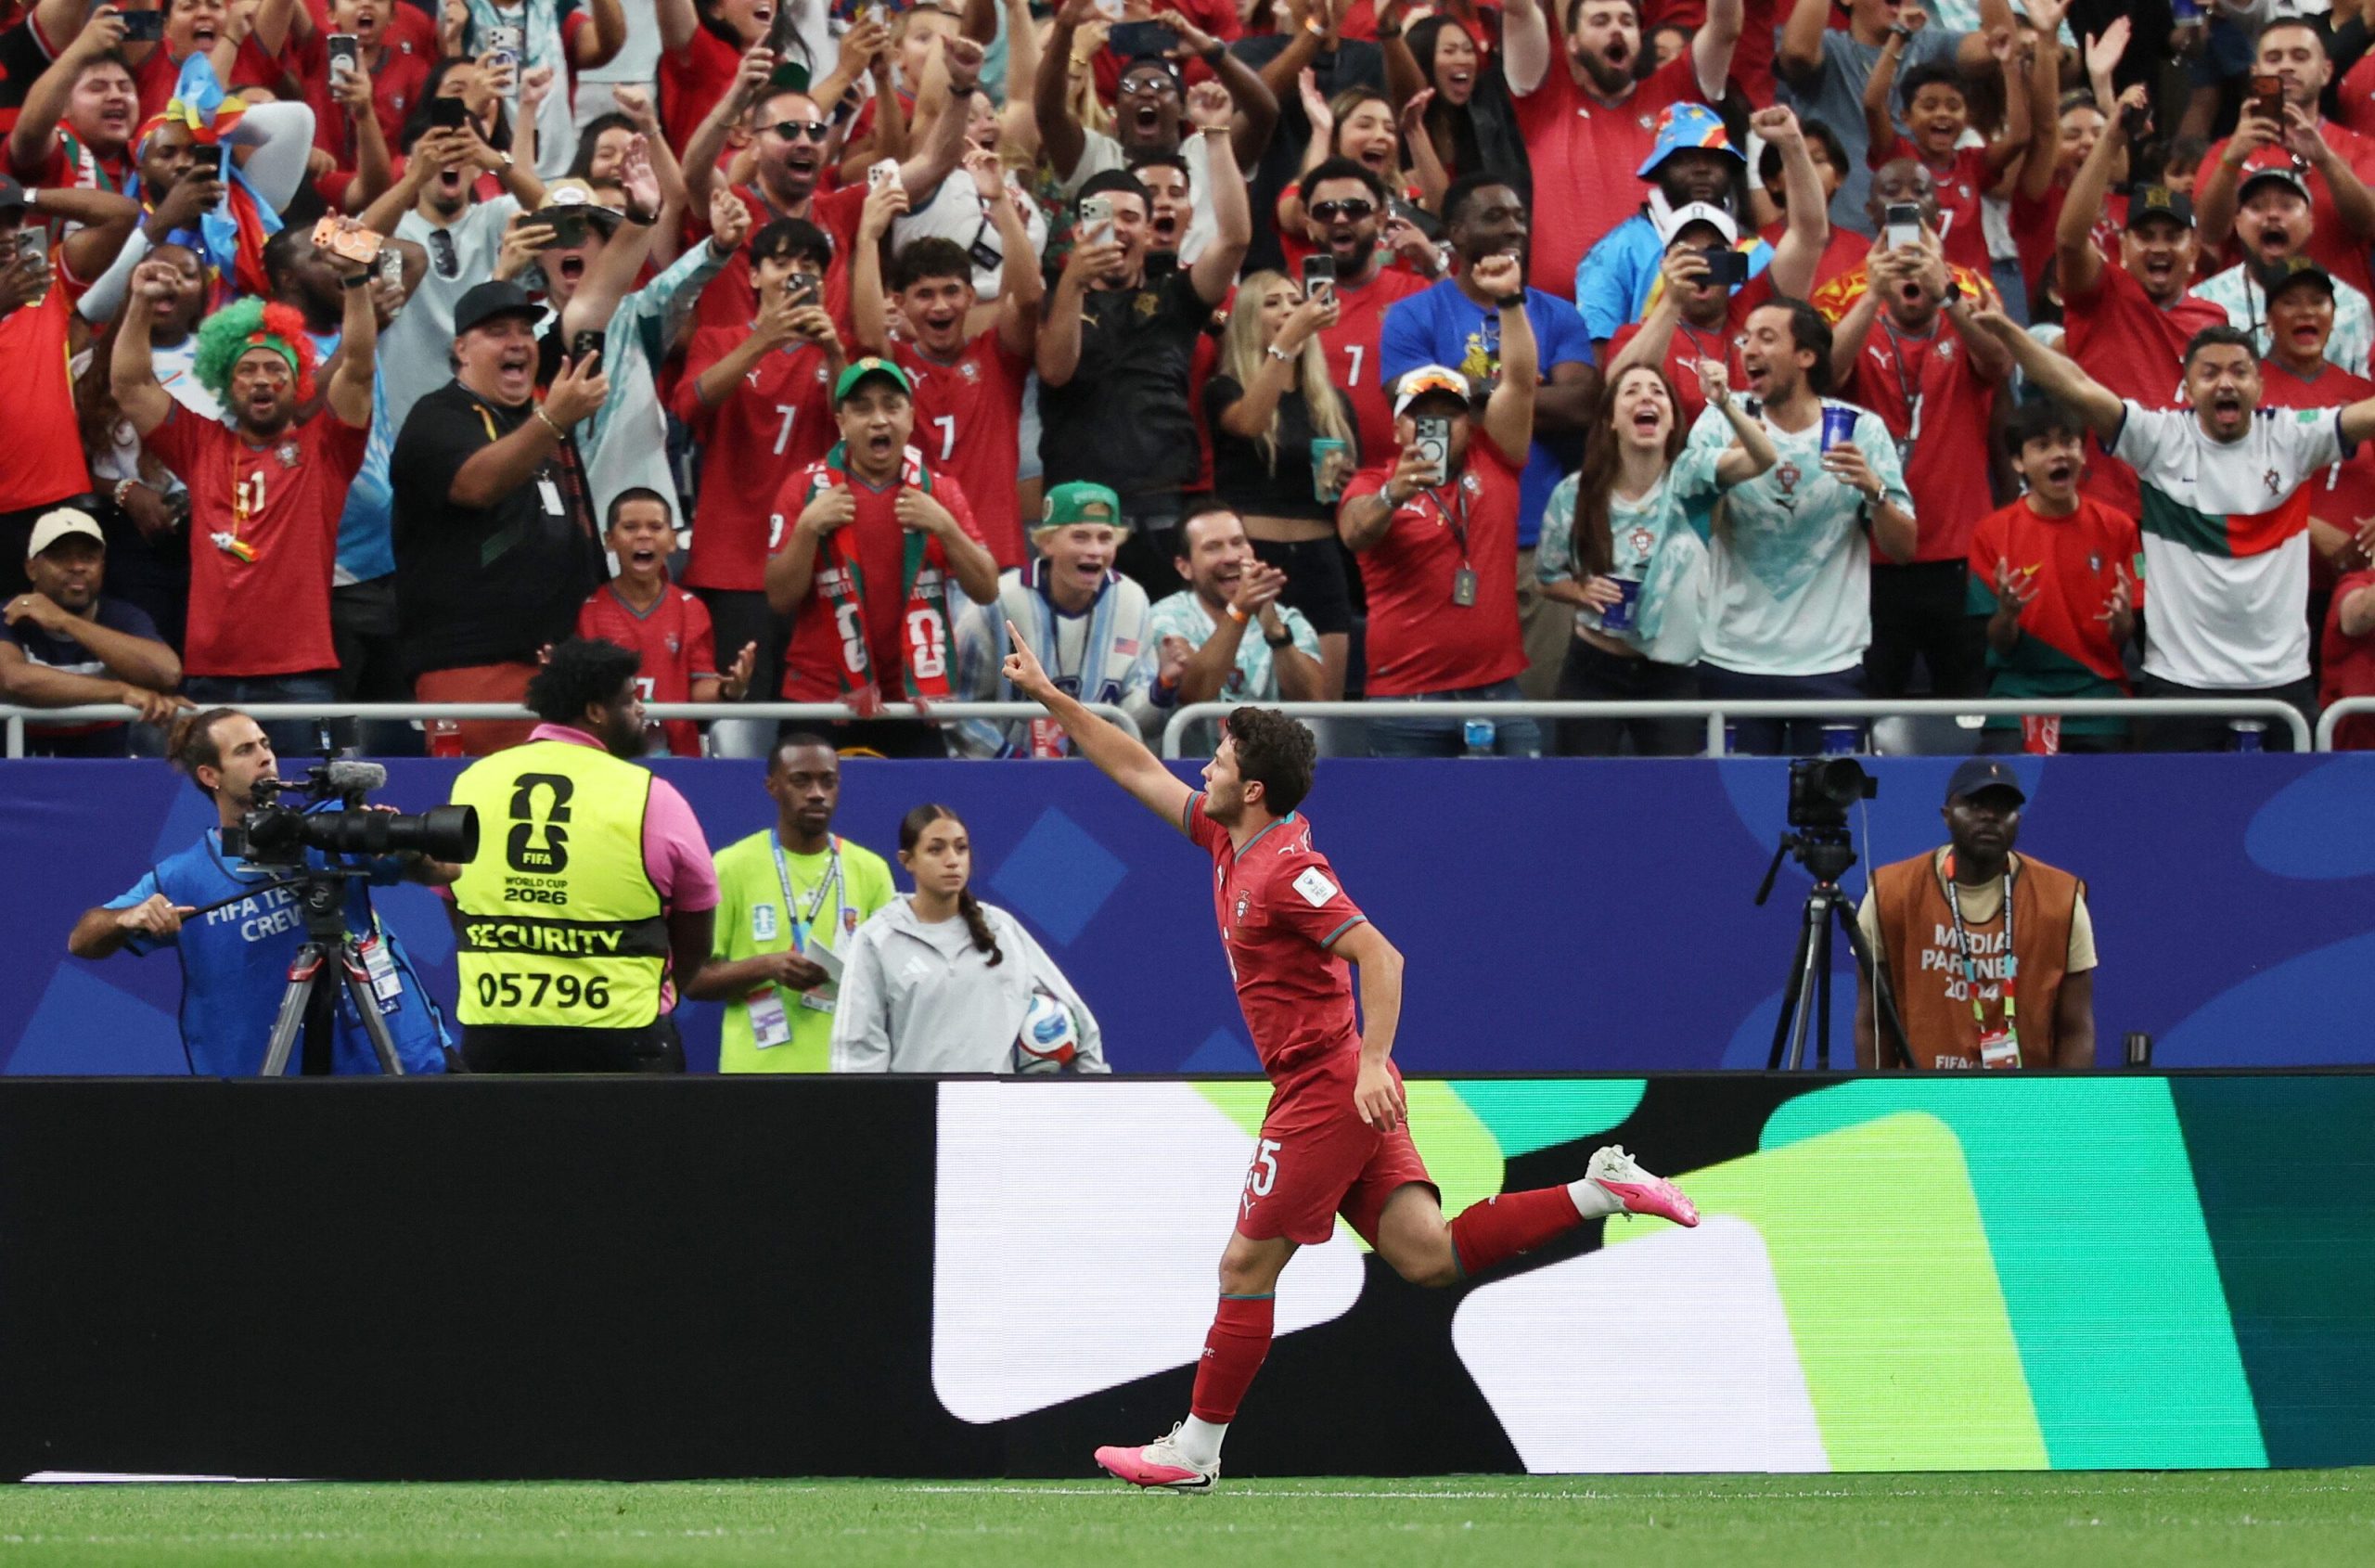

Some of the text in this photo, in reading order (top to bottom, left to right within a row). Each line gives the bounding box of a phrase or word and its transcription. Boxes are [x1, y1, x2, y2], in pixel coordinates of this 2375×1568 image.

[1344, 345, 1364, 387] 7
[773, 405, 797, 455] 7
[933, 416, 955, 460] 7
[522, 852, 553, 866] FIFA
[504, 888, 568, 906] 2026
[505, 877, 545, 888] WORLD
[546, 878, 569, 889] CUP
[206, 897, 260, 926] FIFA
[466, 923, 623, 955] SECURITY
[478, 972, 610, 1009] 05796
